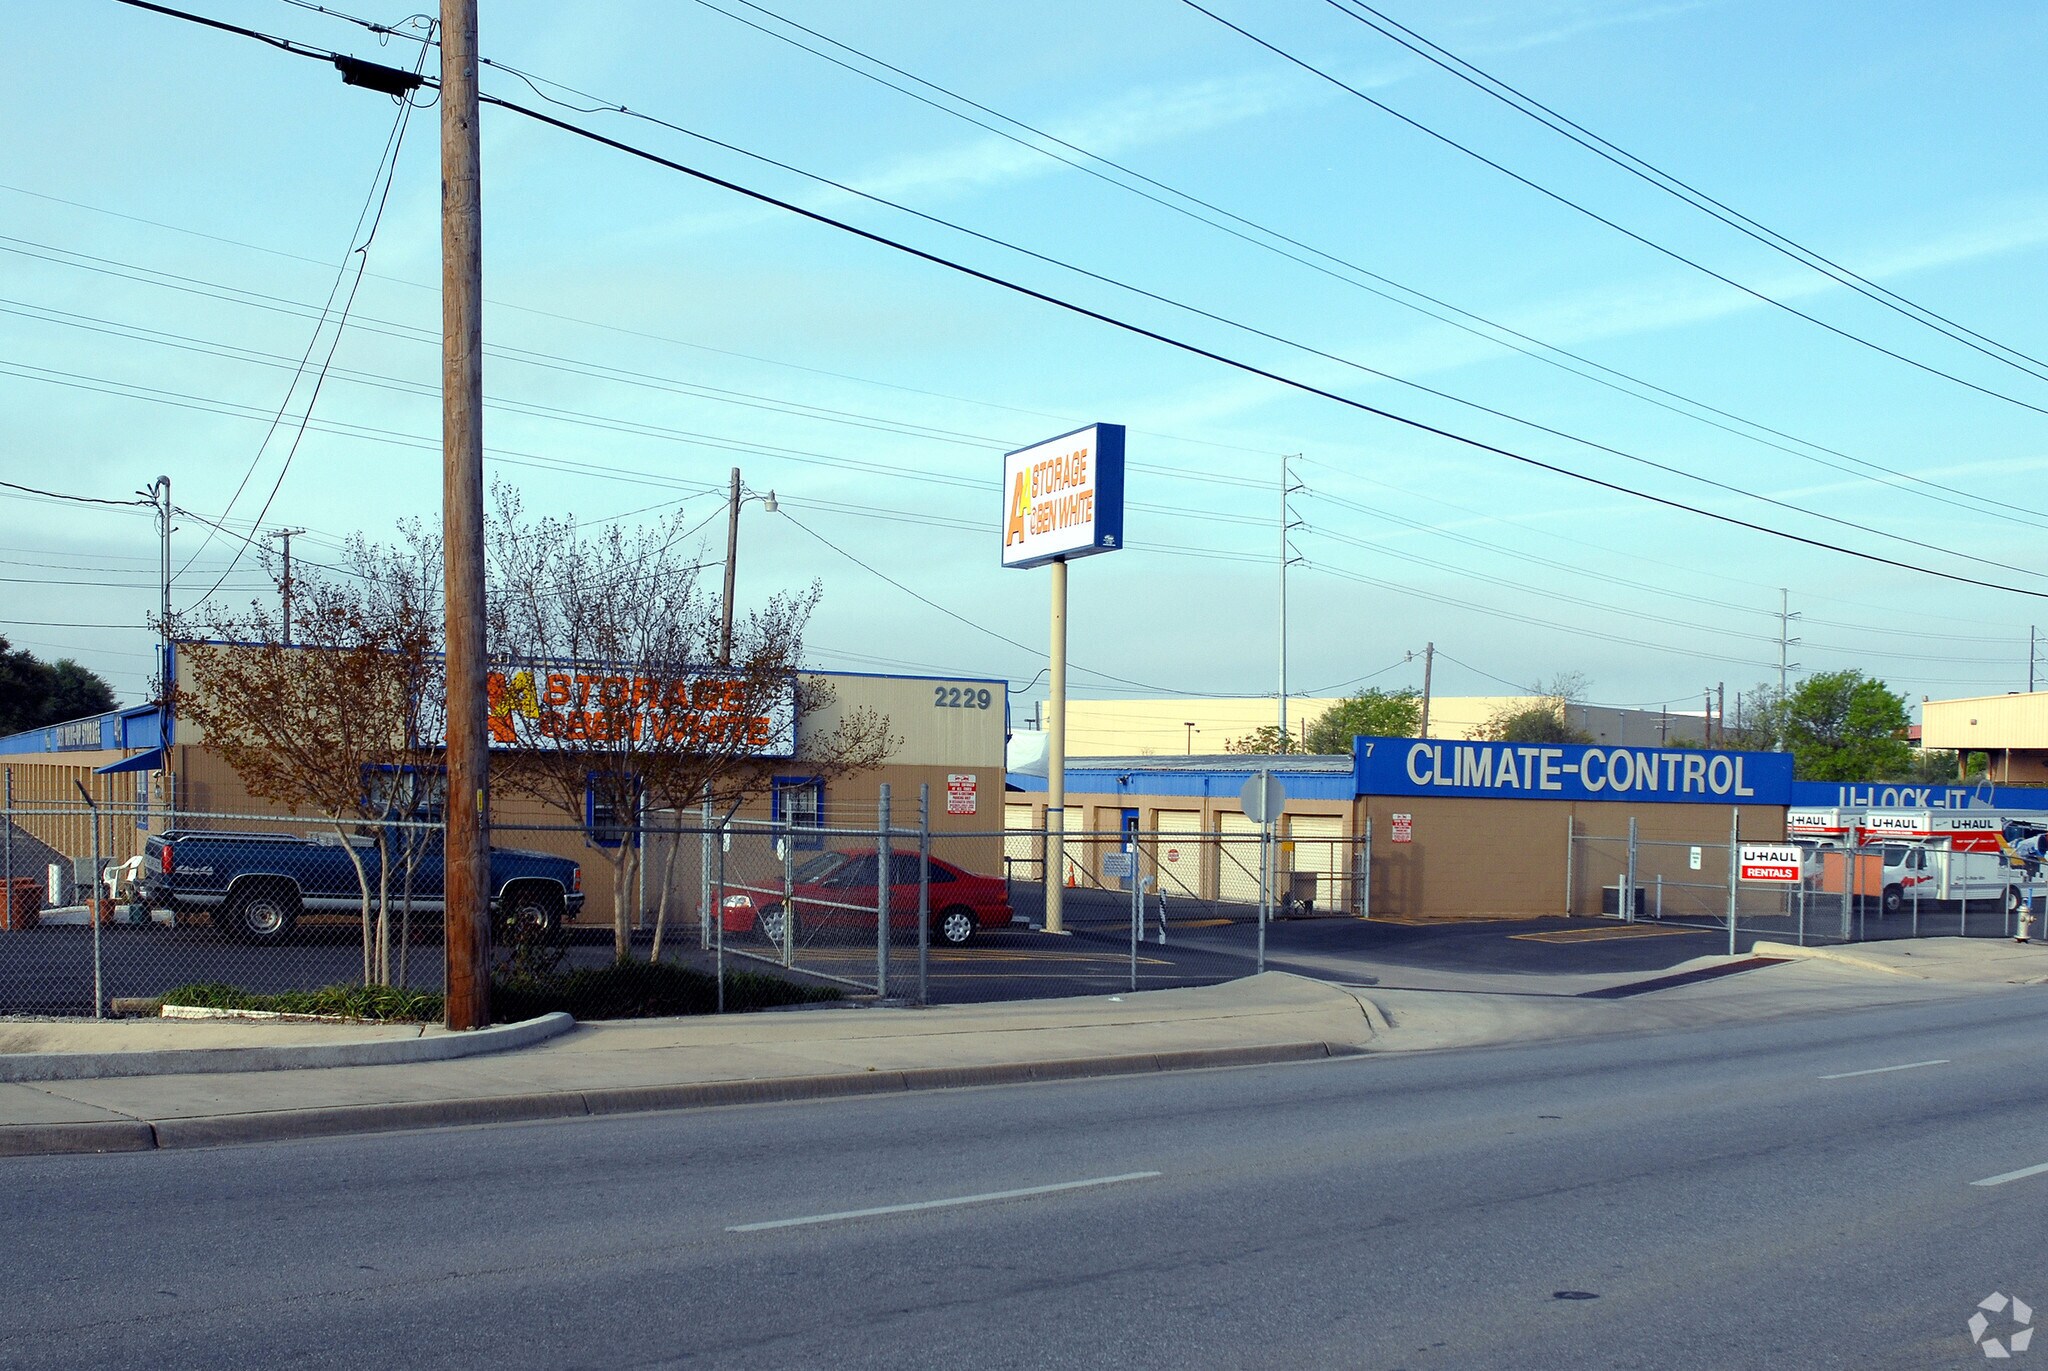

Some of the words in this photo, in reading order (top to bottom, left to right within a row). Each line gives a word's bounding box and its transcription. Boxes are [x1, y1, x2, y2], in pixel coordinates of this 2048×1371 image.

[1031, 448, 1088, 499] STORAGE
[1058, 488, 1094, 529] WHITE
[934, 686, 992, 710] 2229
[652, 715, 771, 746] WHITE
[1365, 743, 1375, 758] 7
[1406, 743, 1755, 797] CLIMATE-CONTROL
[1872, 818, 1918, 829] U-HAUL
[1951, 819, 1994, 829] U-HAUL
[1744, 851, 1797, 862] U-HAUL
[1746, 868, 1793, 879] RENTALS
